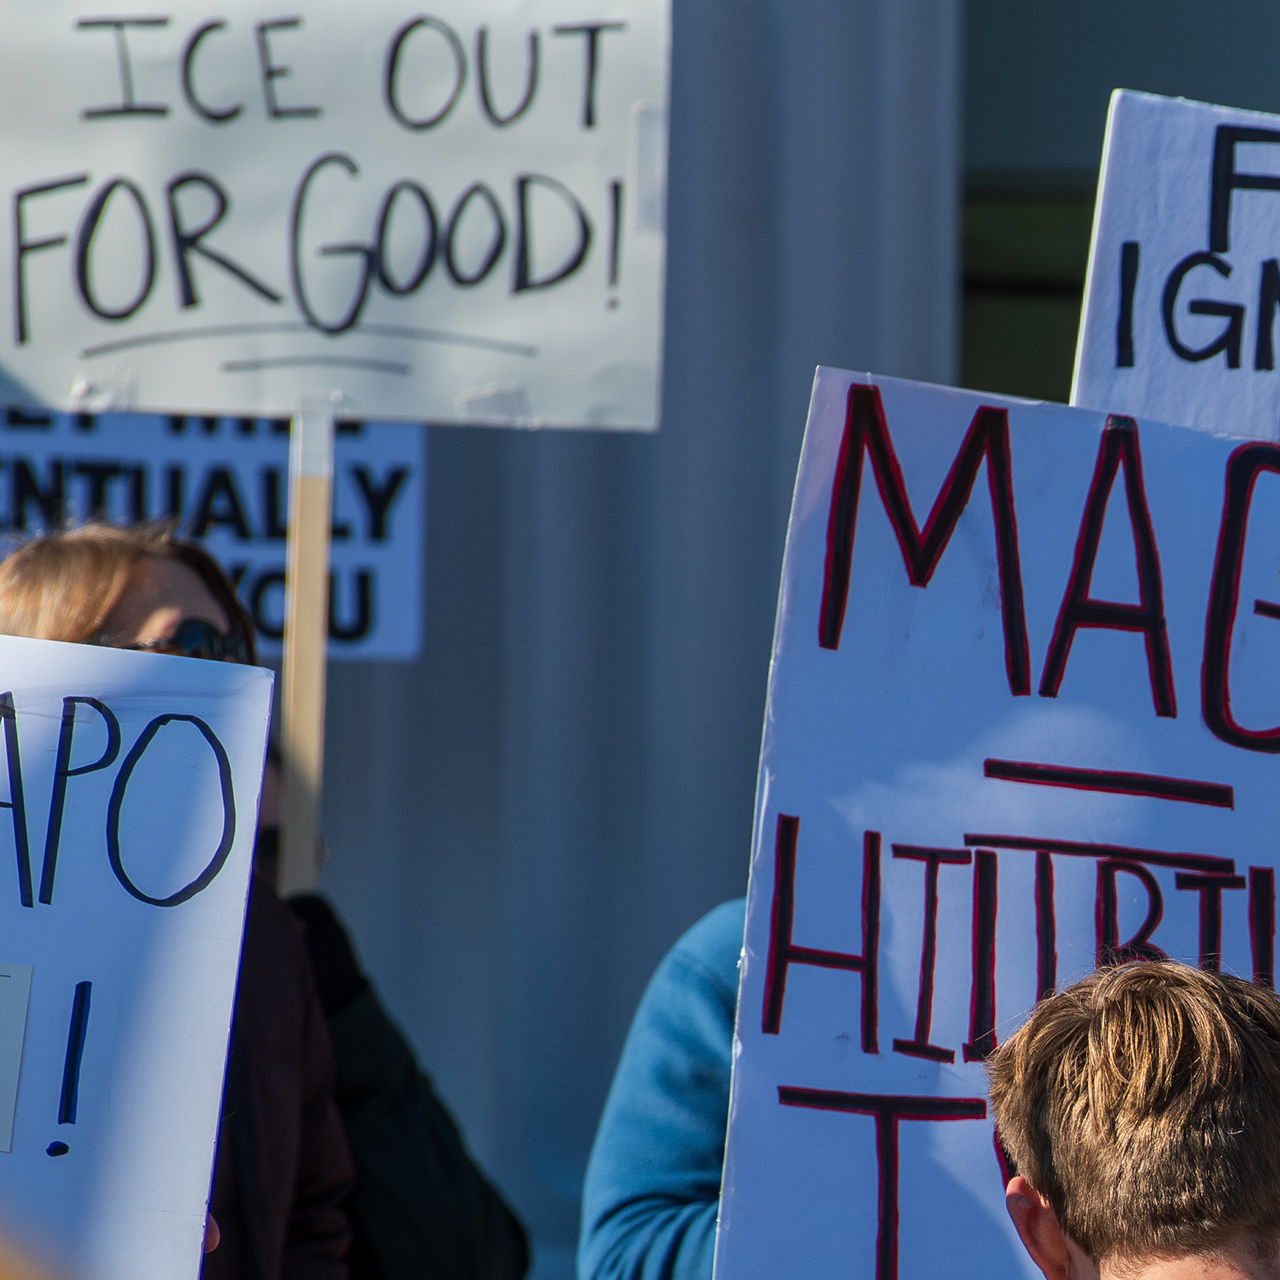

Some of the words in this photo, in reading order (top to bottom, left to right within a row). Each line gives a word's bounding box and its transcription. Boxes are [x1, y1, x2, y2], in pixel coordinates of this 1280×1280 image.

[76, 16, 323, 121] ICE
[382, 14, 626, 131] OUT
[13, 170, 283, 345] FOR
[288, 151, 624, 335] GOOD!
